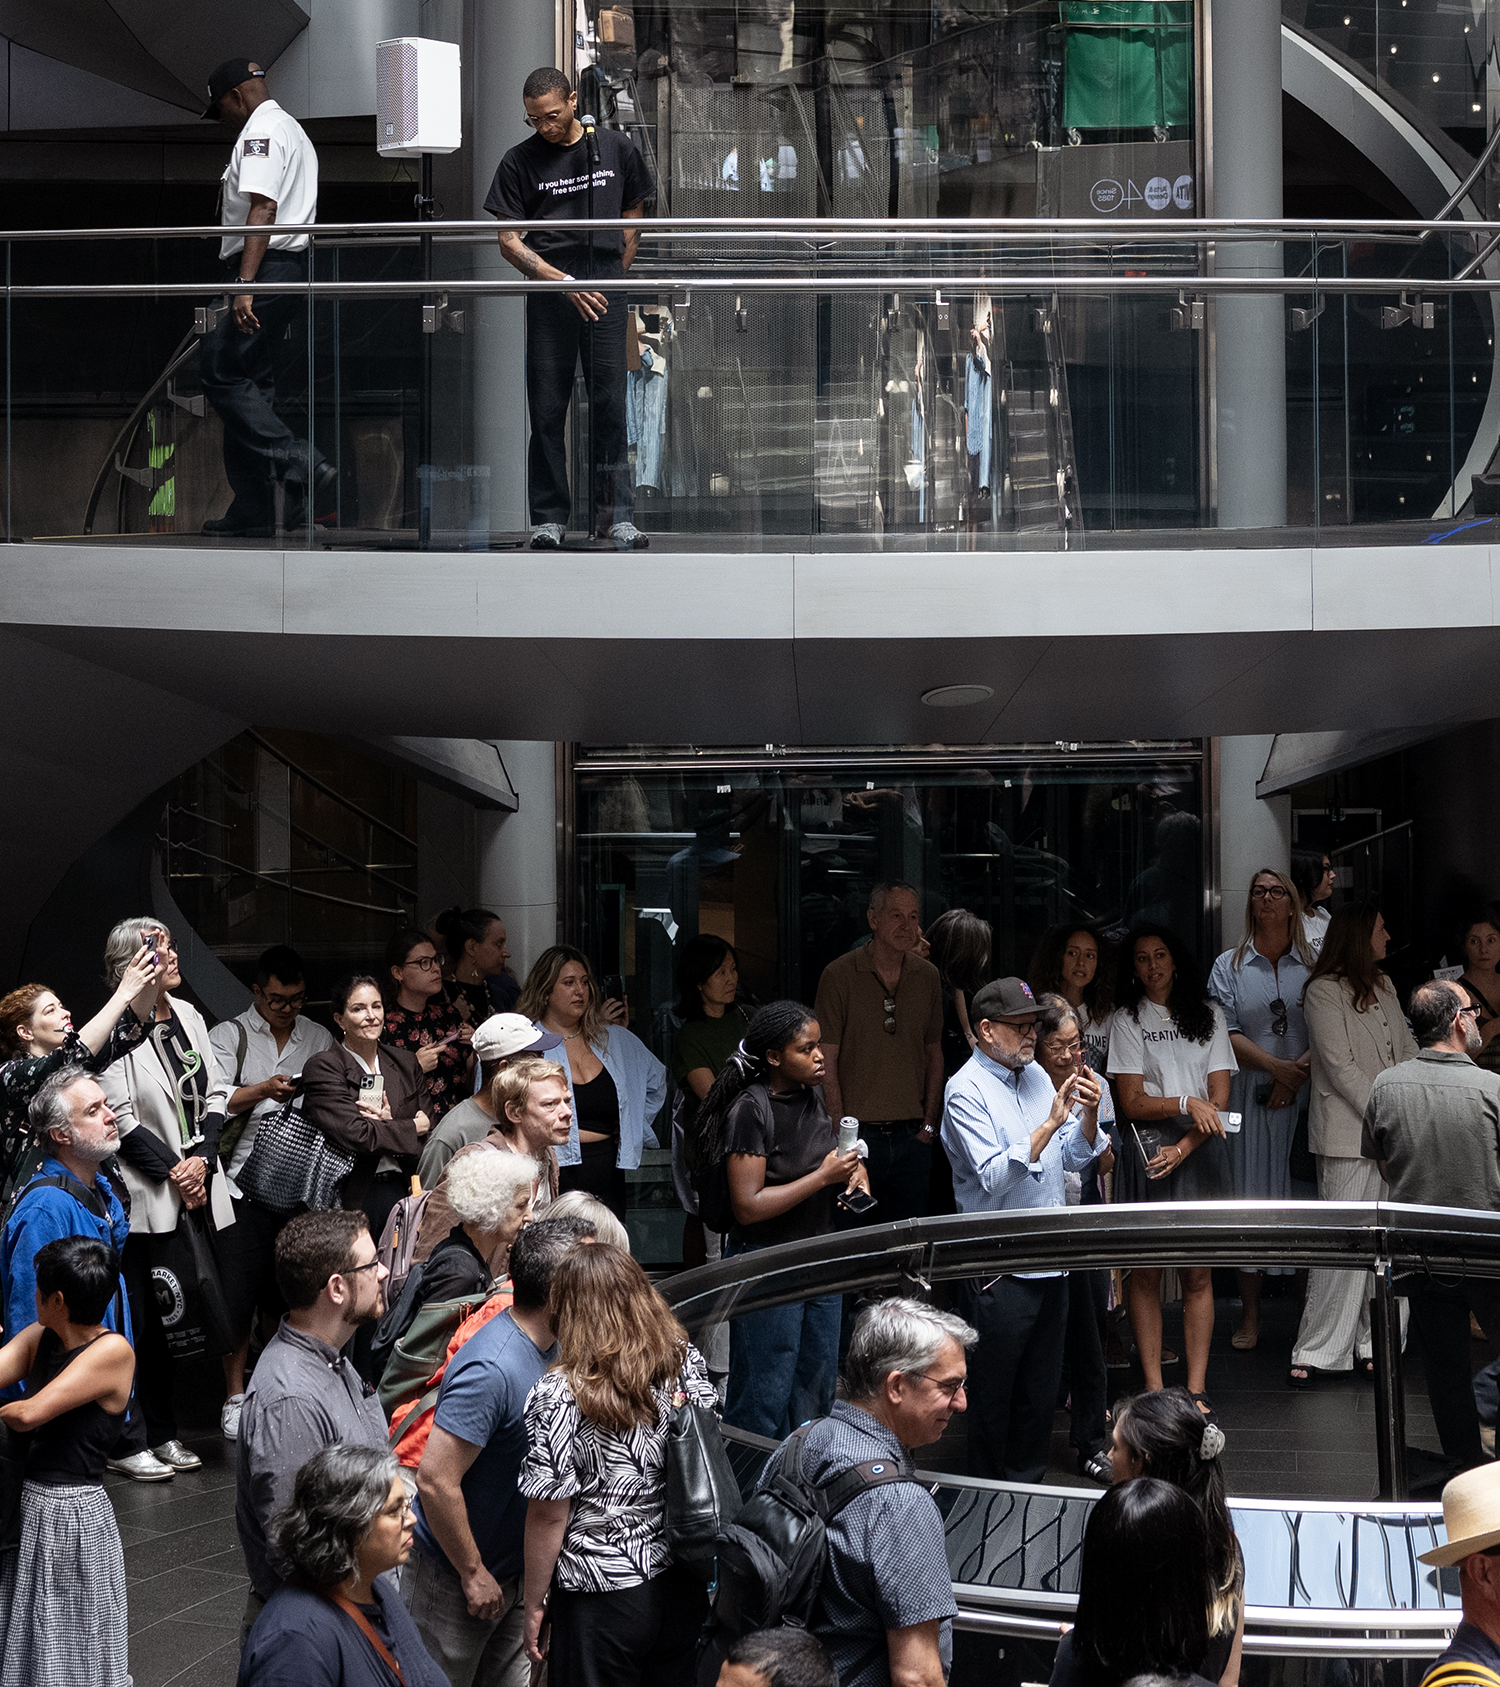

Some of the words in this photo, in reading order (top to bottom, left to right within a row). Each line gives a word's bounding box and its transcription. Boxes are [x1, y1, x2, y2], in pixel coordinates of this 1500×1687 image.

[538, 183, 545, 191] If
[545, 180, 559, 190] you
[559, 177, 576, 187] hear
[552, 185, 567, 196] free
[1142, 1026, 1183, 1044] CREATIV
[174, 1291, 183, 1310] NYC
